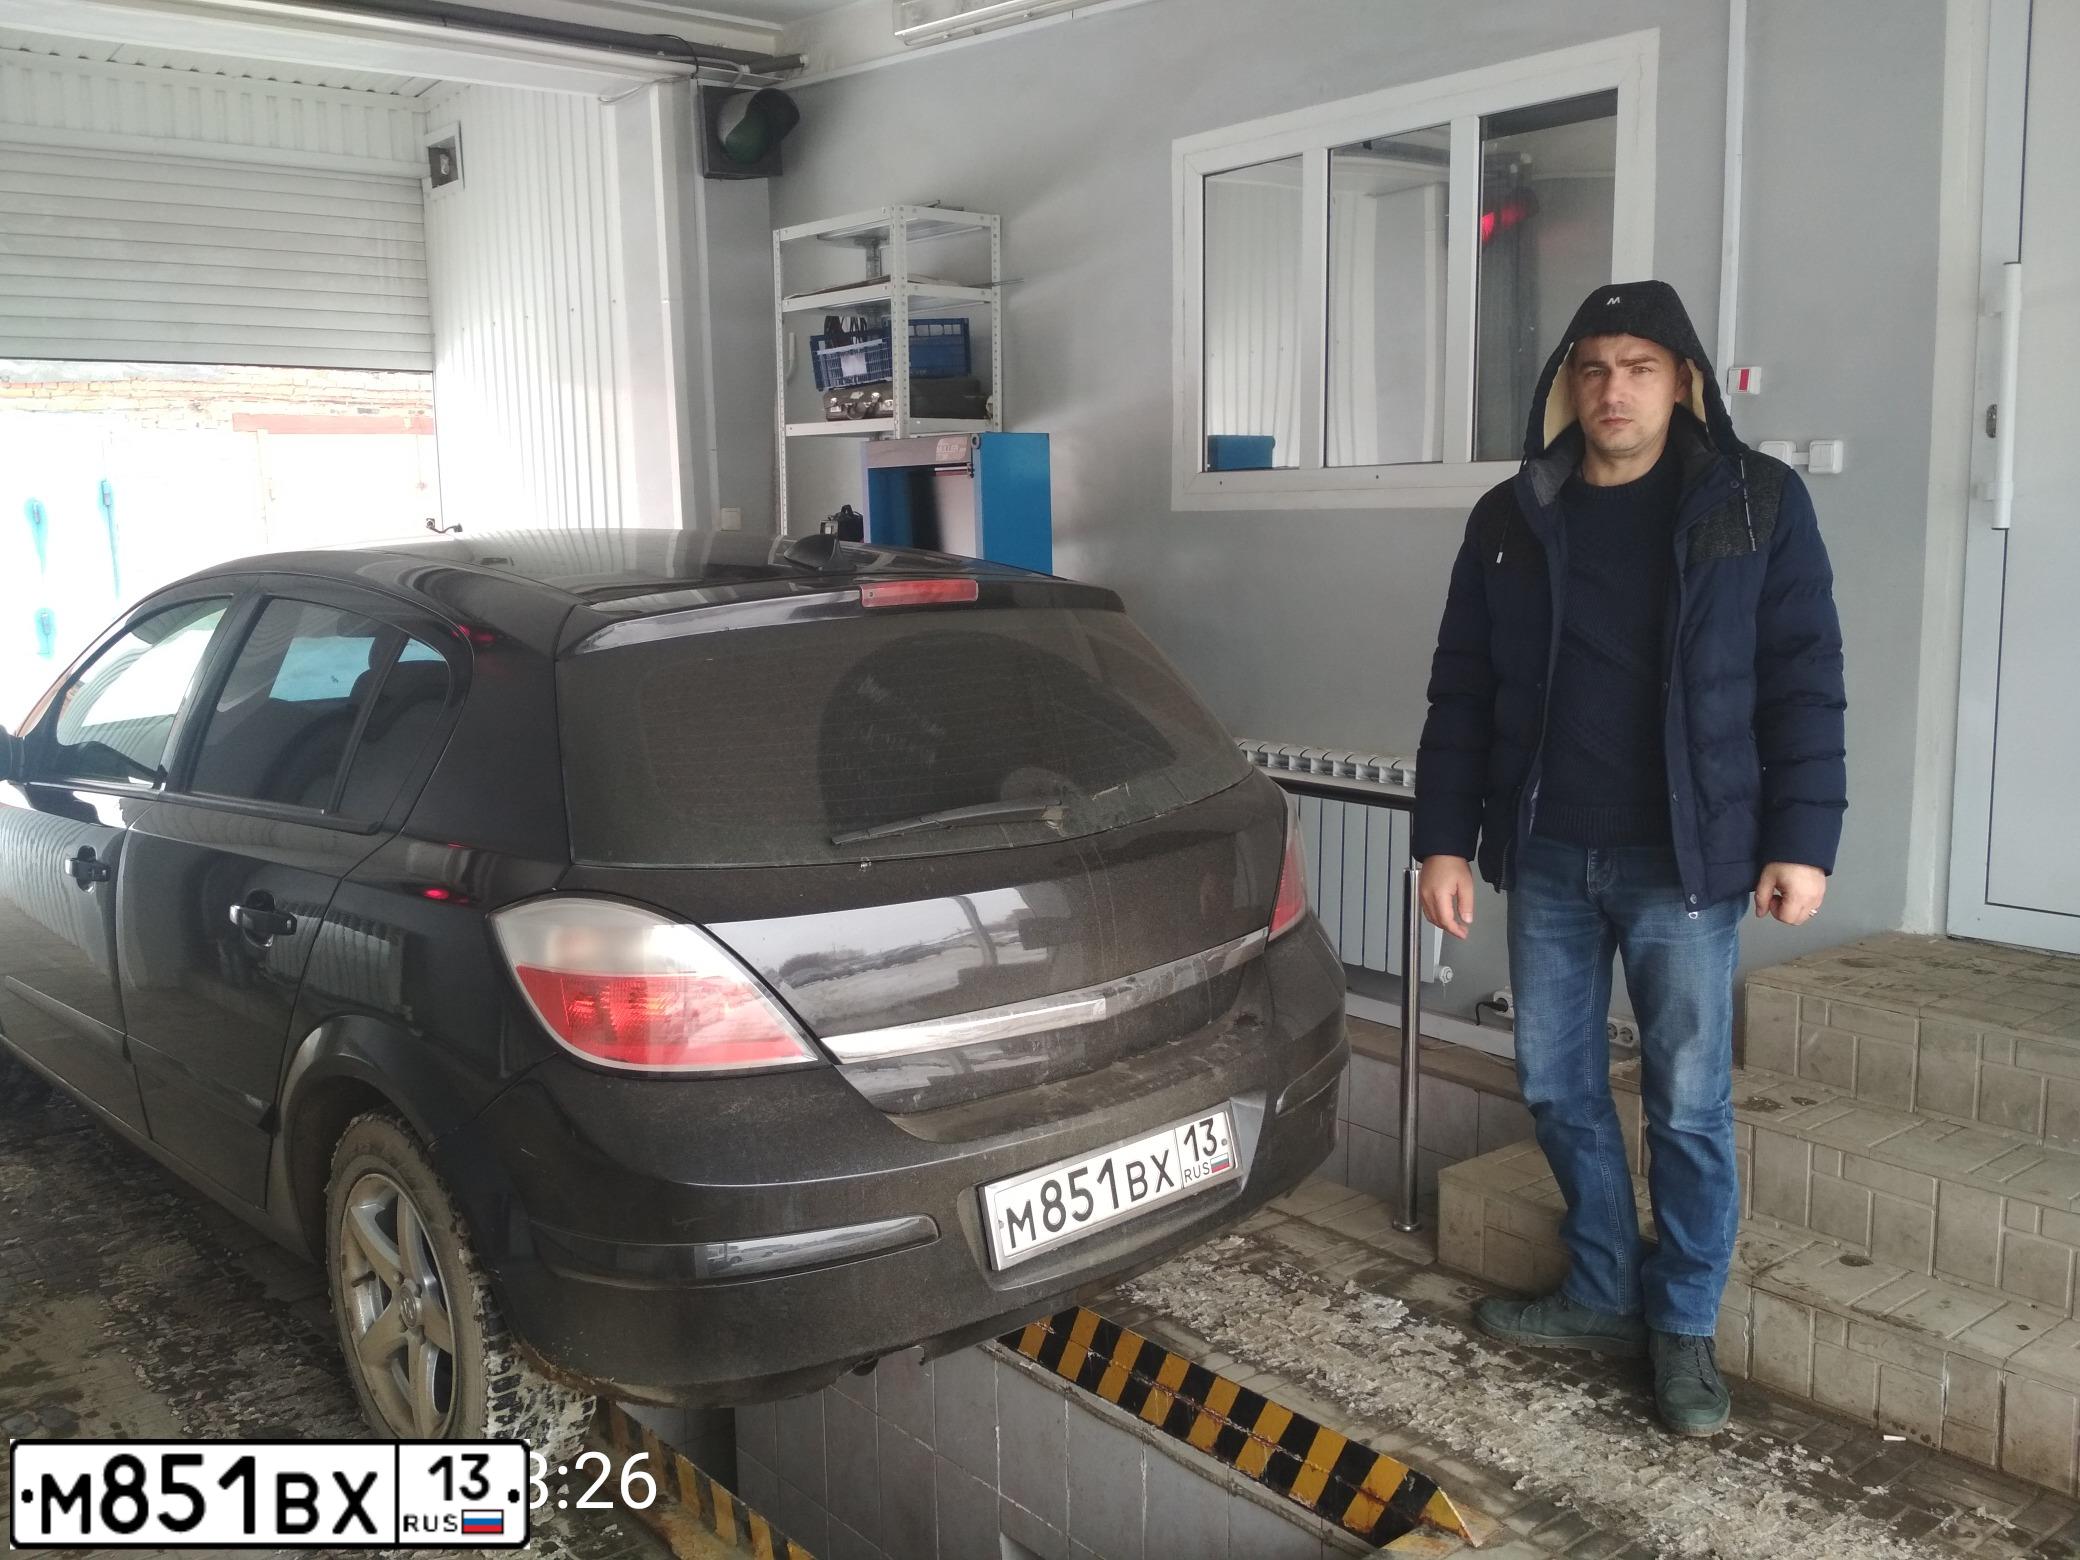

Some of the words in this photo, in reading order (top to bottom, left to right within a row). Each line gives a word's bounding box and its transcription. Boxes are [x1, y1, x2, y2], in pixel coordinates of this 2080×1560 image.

[1006, 1149, 1175, 1248] М851ВХ
[1184, 1118, 1217, 1162] 13
[1184, 1162, 1210, 1183] RUS
